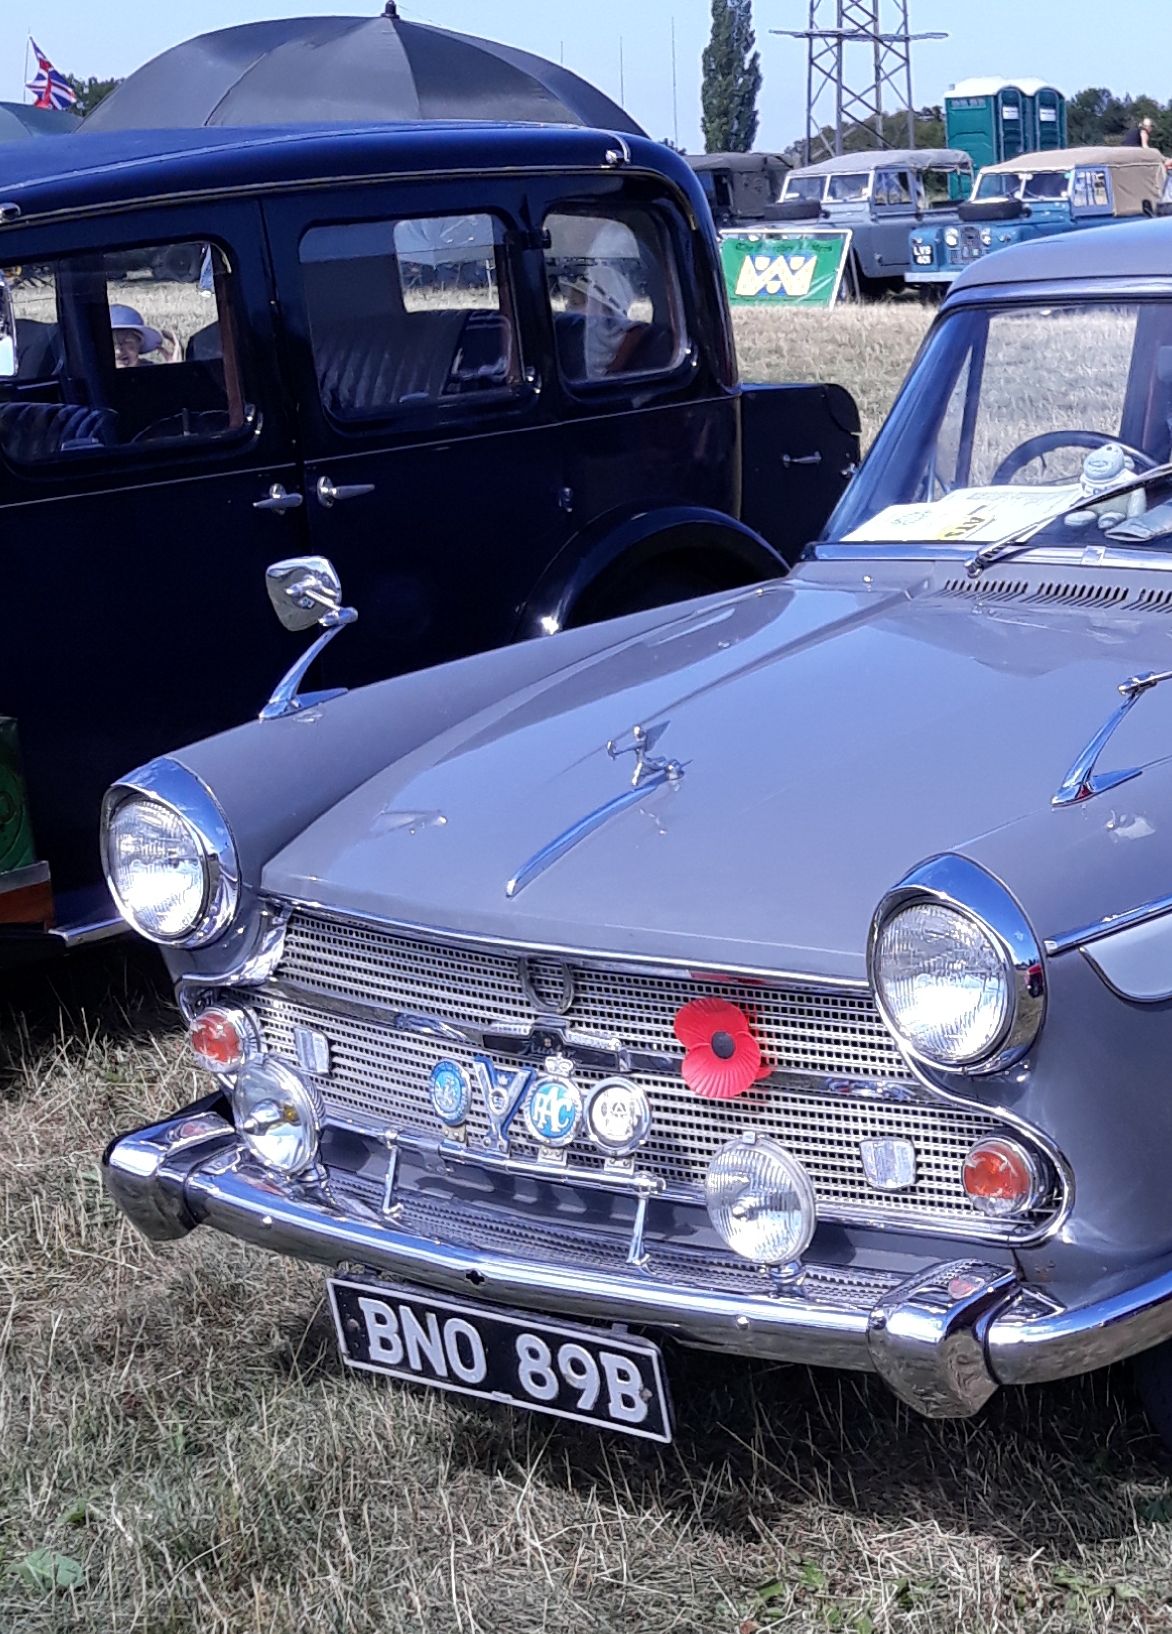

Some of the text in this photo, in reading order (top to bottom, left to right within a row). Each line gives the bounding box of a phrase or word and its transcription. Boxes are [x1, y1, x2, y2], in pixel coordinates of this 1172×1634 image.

[533, 1086, 573, 1133] RAC
[358, 1296, 649, 1423] BNO 89B
